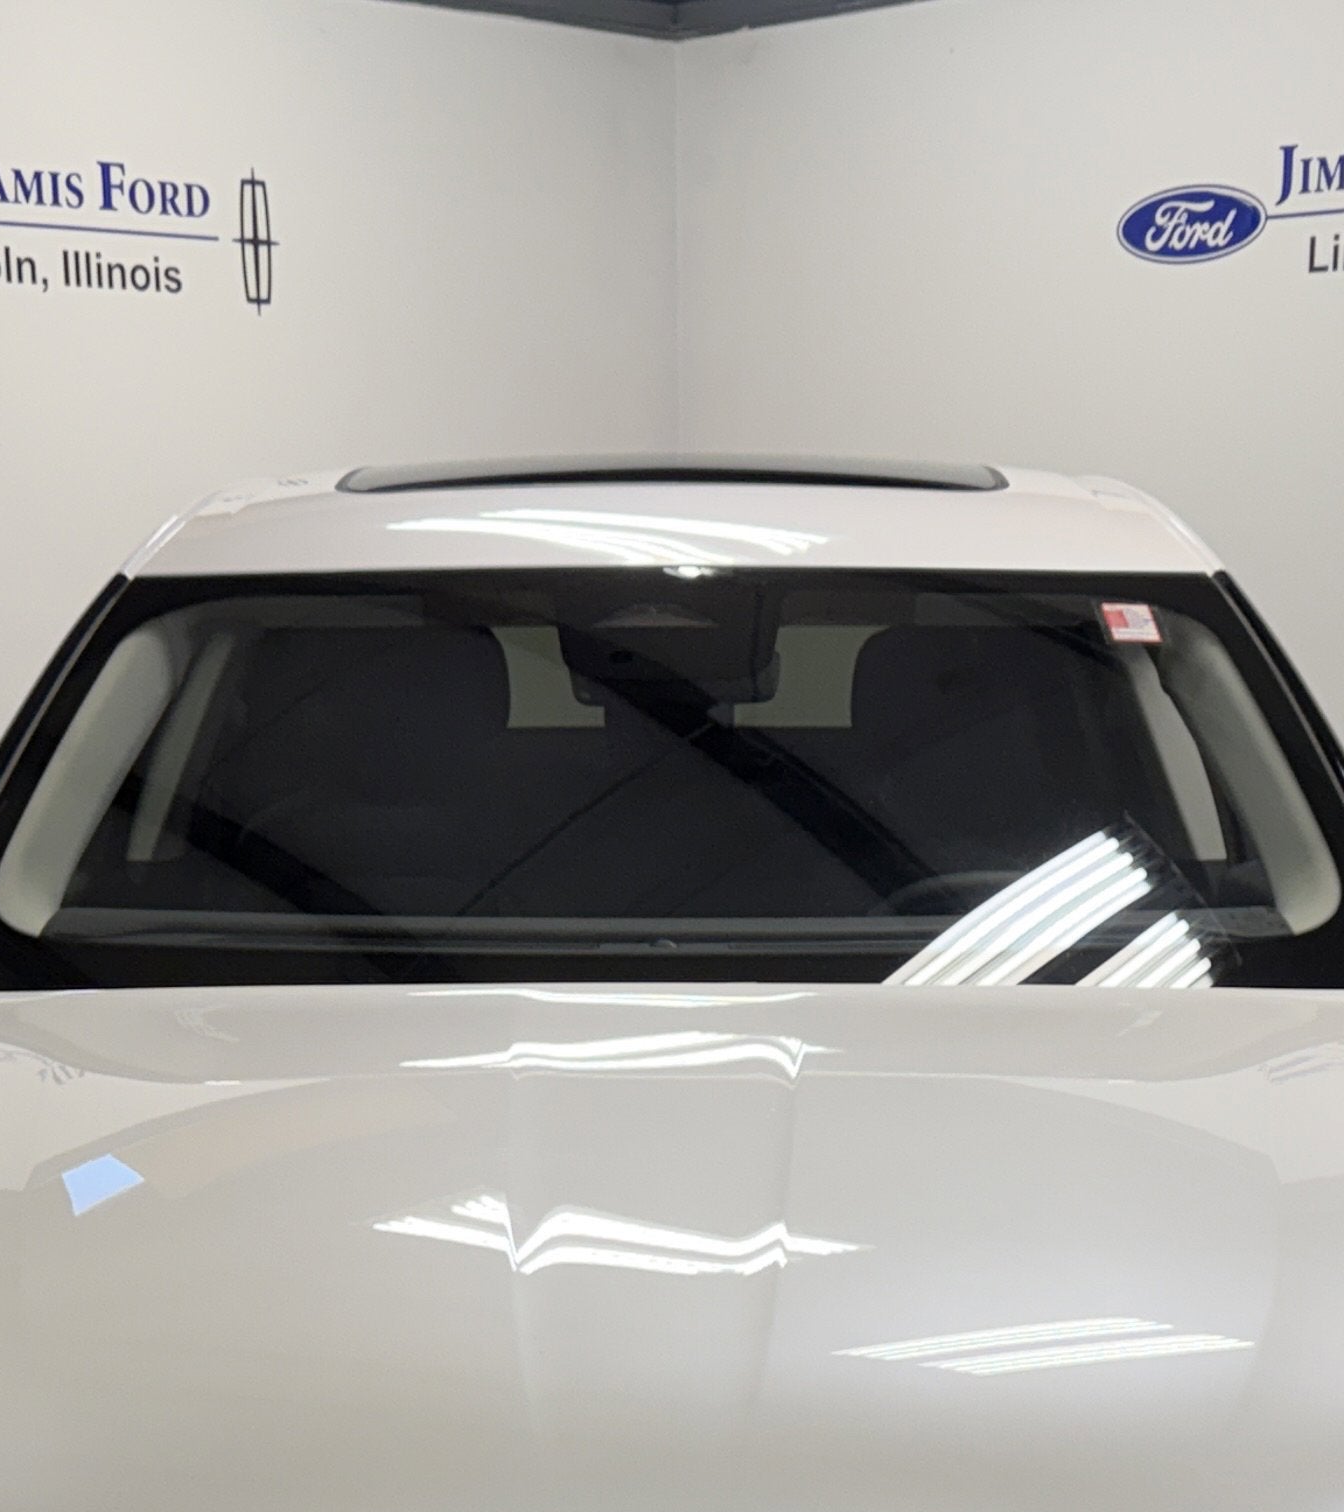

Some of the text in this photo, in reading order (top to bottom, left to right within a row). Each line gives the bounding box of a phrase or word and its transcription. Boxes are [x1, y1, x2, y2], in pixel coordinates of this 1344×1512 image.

[97, 160, 211, 218] FORD
[1144, 199, 1233, 253] Ford
[62, 249, 183, 294] Illinois
